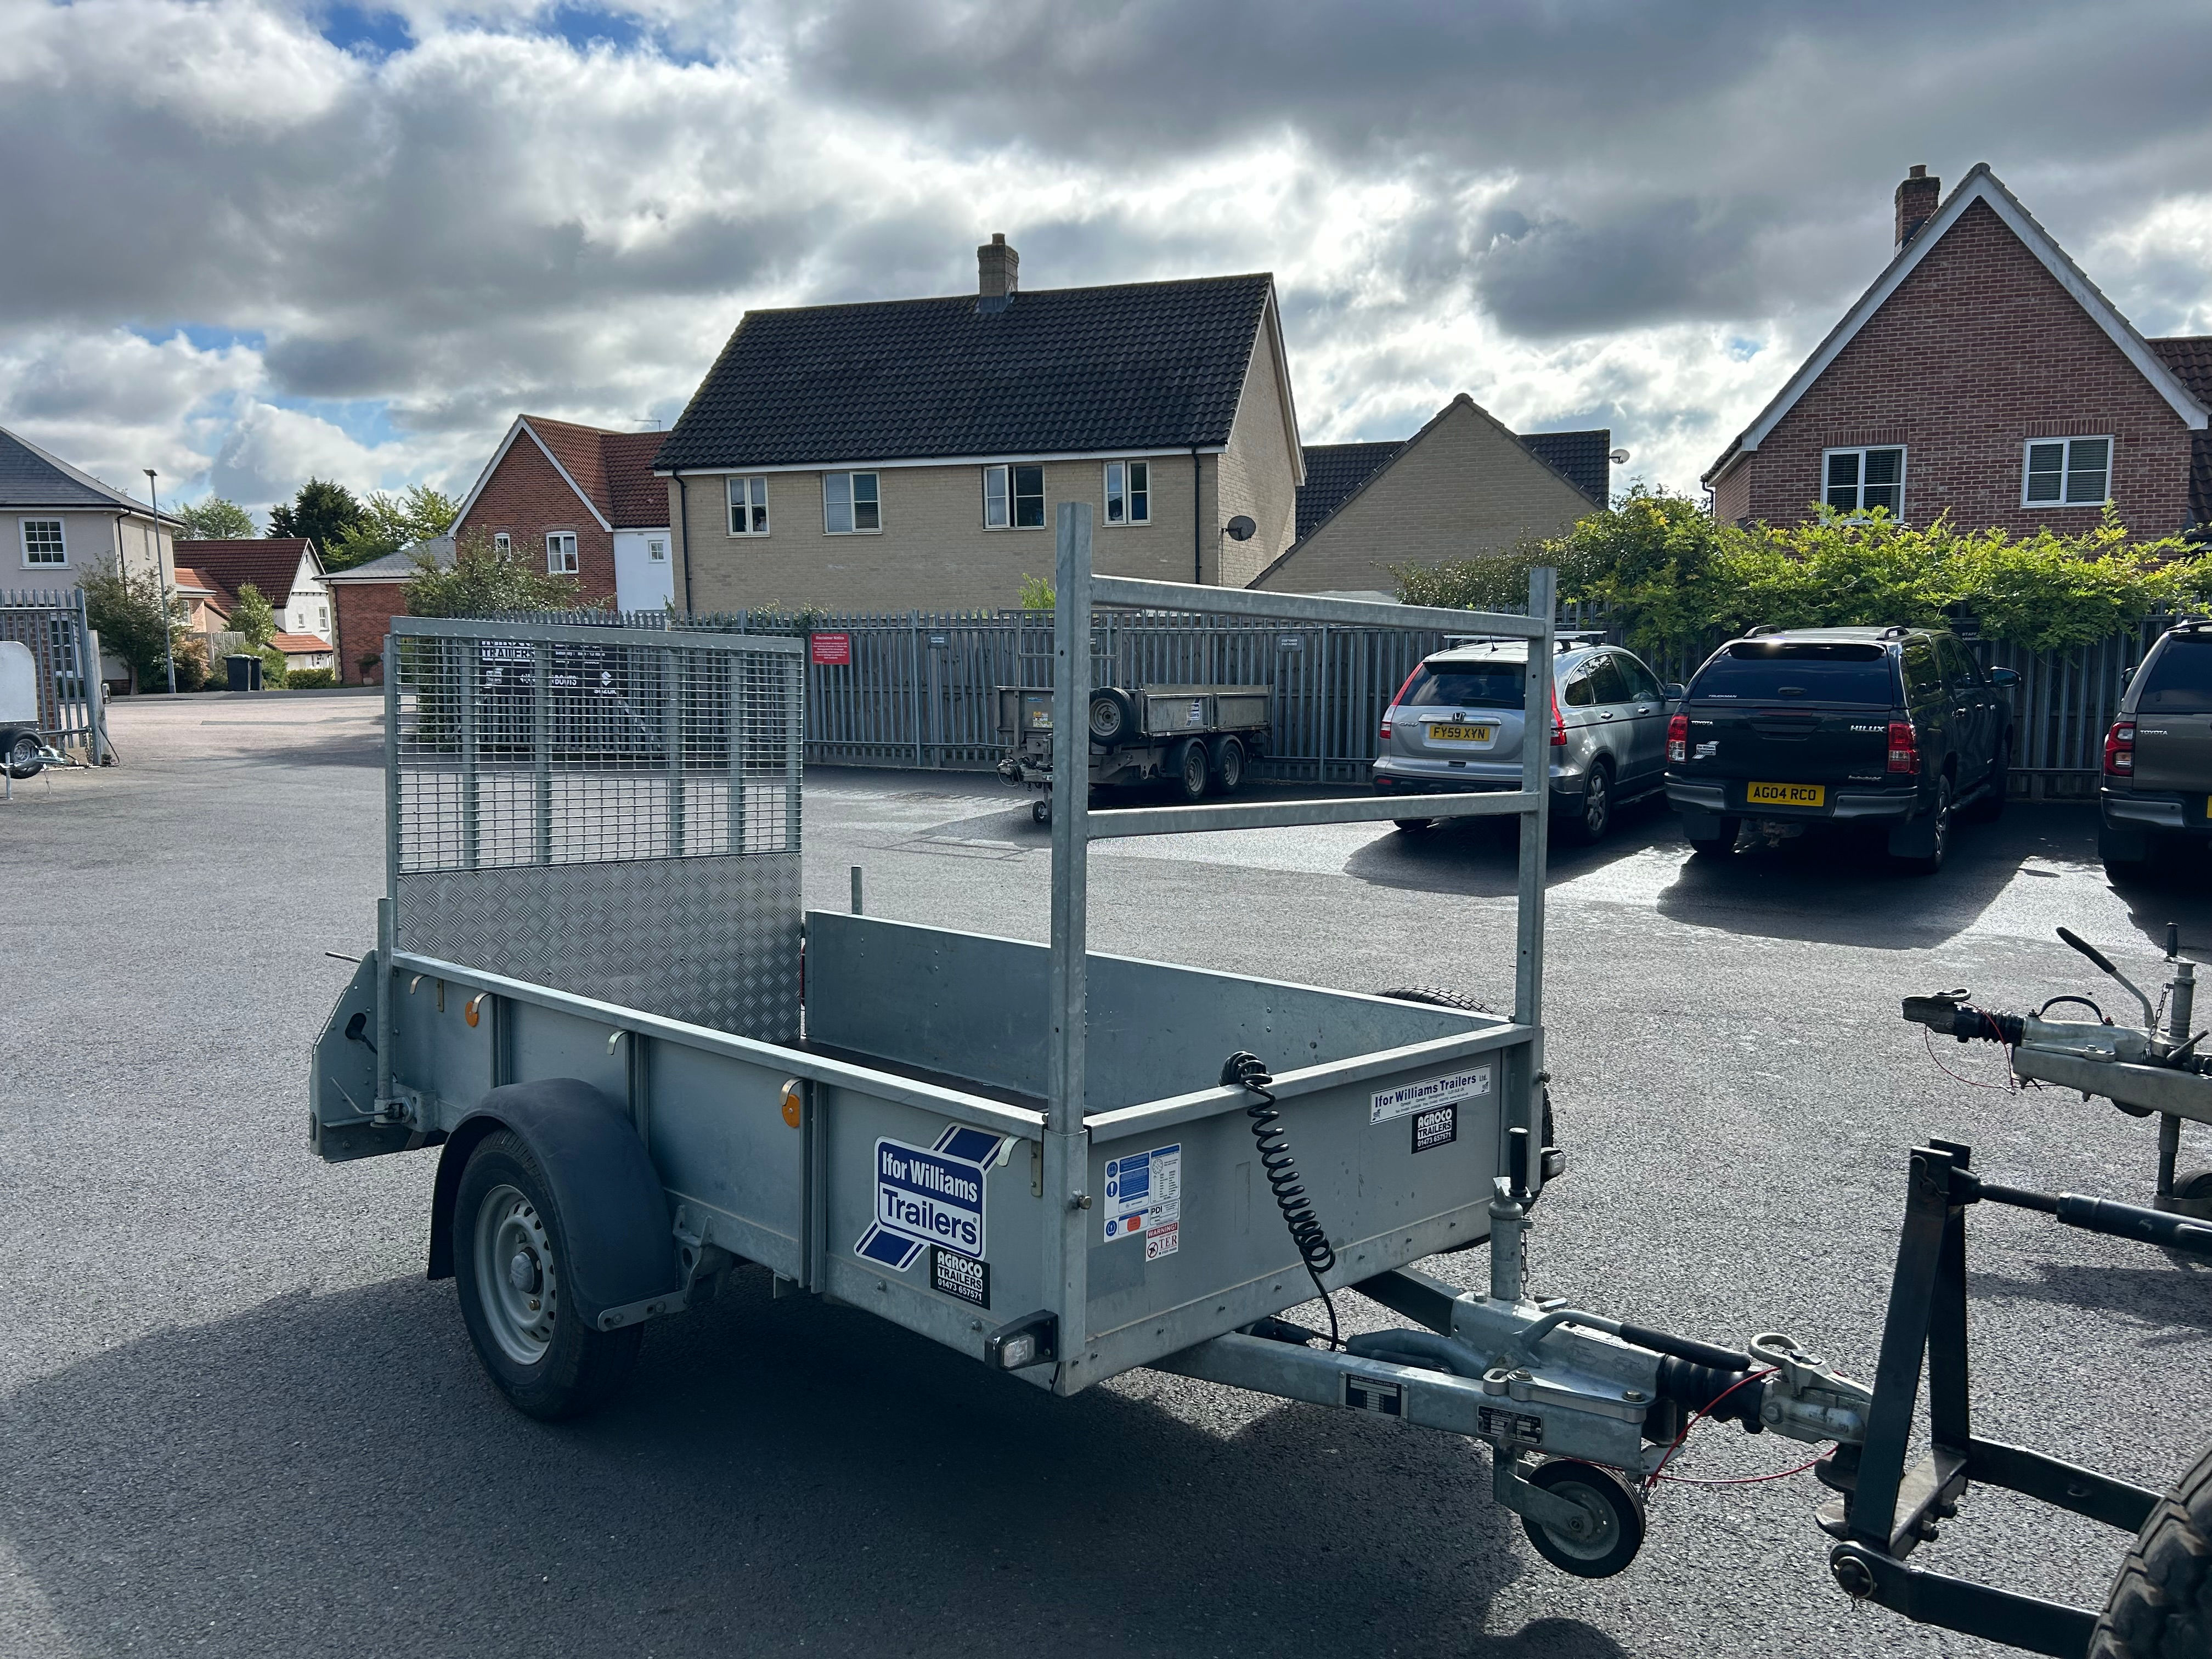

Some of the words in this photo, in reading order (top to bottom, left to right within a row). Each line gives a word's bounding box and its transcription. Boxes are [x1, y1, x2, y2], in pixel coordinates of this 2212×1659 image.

[1434, 727, 1461, 738] FY59
[1464, 728, 1486, 739] XYN
[1753, 786, 1787, 799] AG04
[1790, 788, 1816, 801] RCO
[1375, 1095, 1393, 1108] Ifor
[1395, 1084, 1438, 1102] Williams
[1440, 1075, 1476, 1091] Trailers
[1418, 1108, 1452, 1128] AGROCO
[1418, 1121, 1452, 1138] TRAILERS
[1418, 1137, 1433, 1147] 01473
[1434, 1131, 1452, 1142] 657571
[882, 1150, 907, 1180] Ifor
[909, 1159, 978, 1203] Williams
[882, 1188, 977, 1245] Trailers
[1151, 1205, 1163, 1216] PDI
[1148, 1224, 1177, 1238] WARNING!
[1159, 1235, 1177, 1249] TER
[937, 1251, 983, 1278] AGROCO
[938, 1266, 982, 1290] TRAILERS
[938, 1278, 957, 1291] 01473
[958, 1285, 982, 1301] 657571
